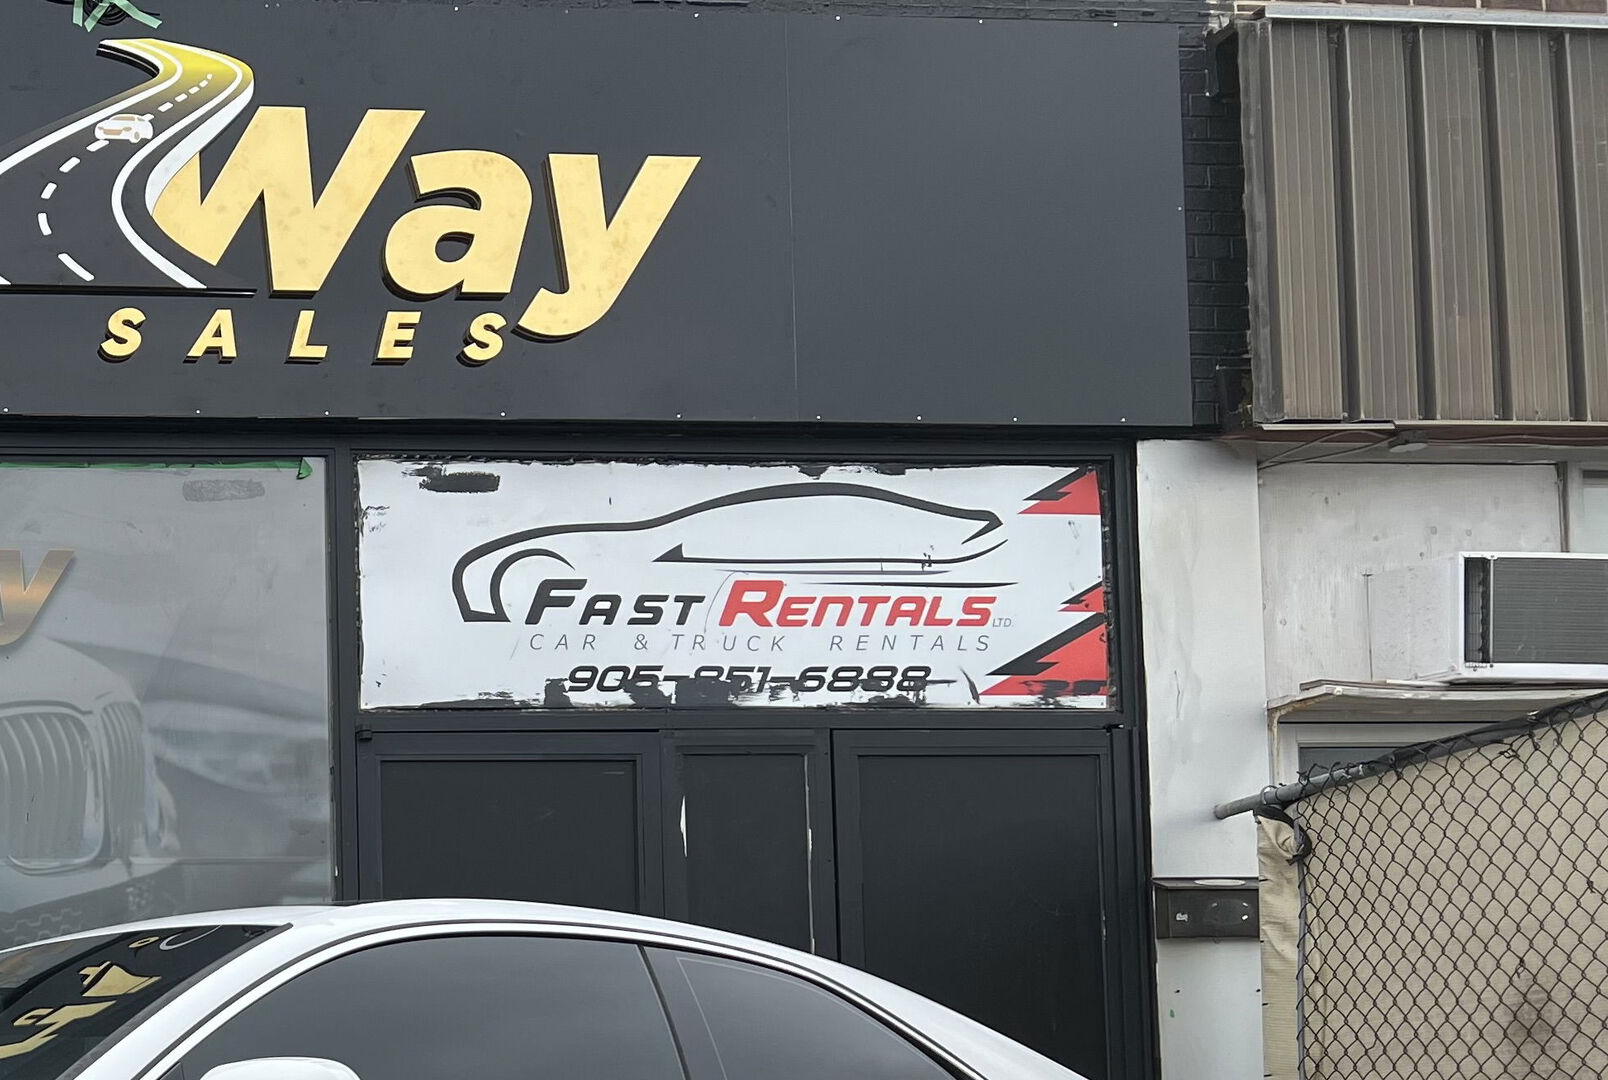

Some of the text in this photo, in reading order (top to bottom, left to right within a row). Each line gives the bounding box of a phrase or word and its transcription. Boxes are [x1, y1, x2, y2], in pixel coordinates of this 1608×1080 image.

[152, 106, 702, 339] Way
[99, 307, 508, 363] SALES
[529, 633, 990, 652] CAR & TRUCK RENTALS
